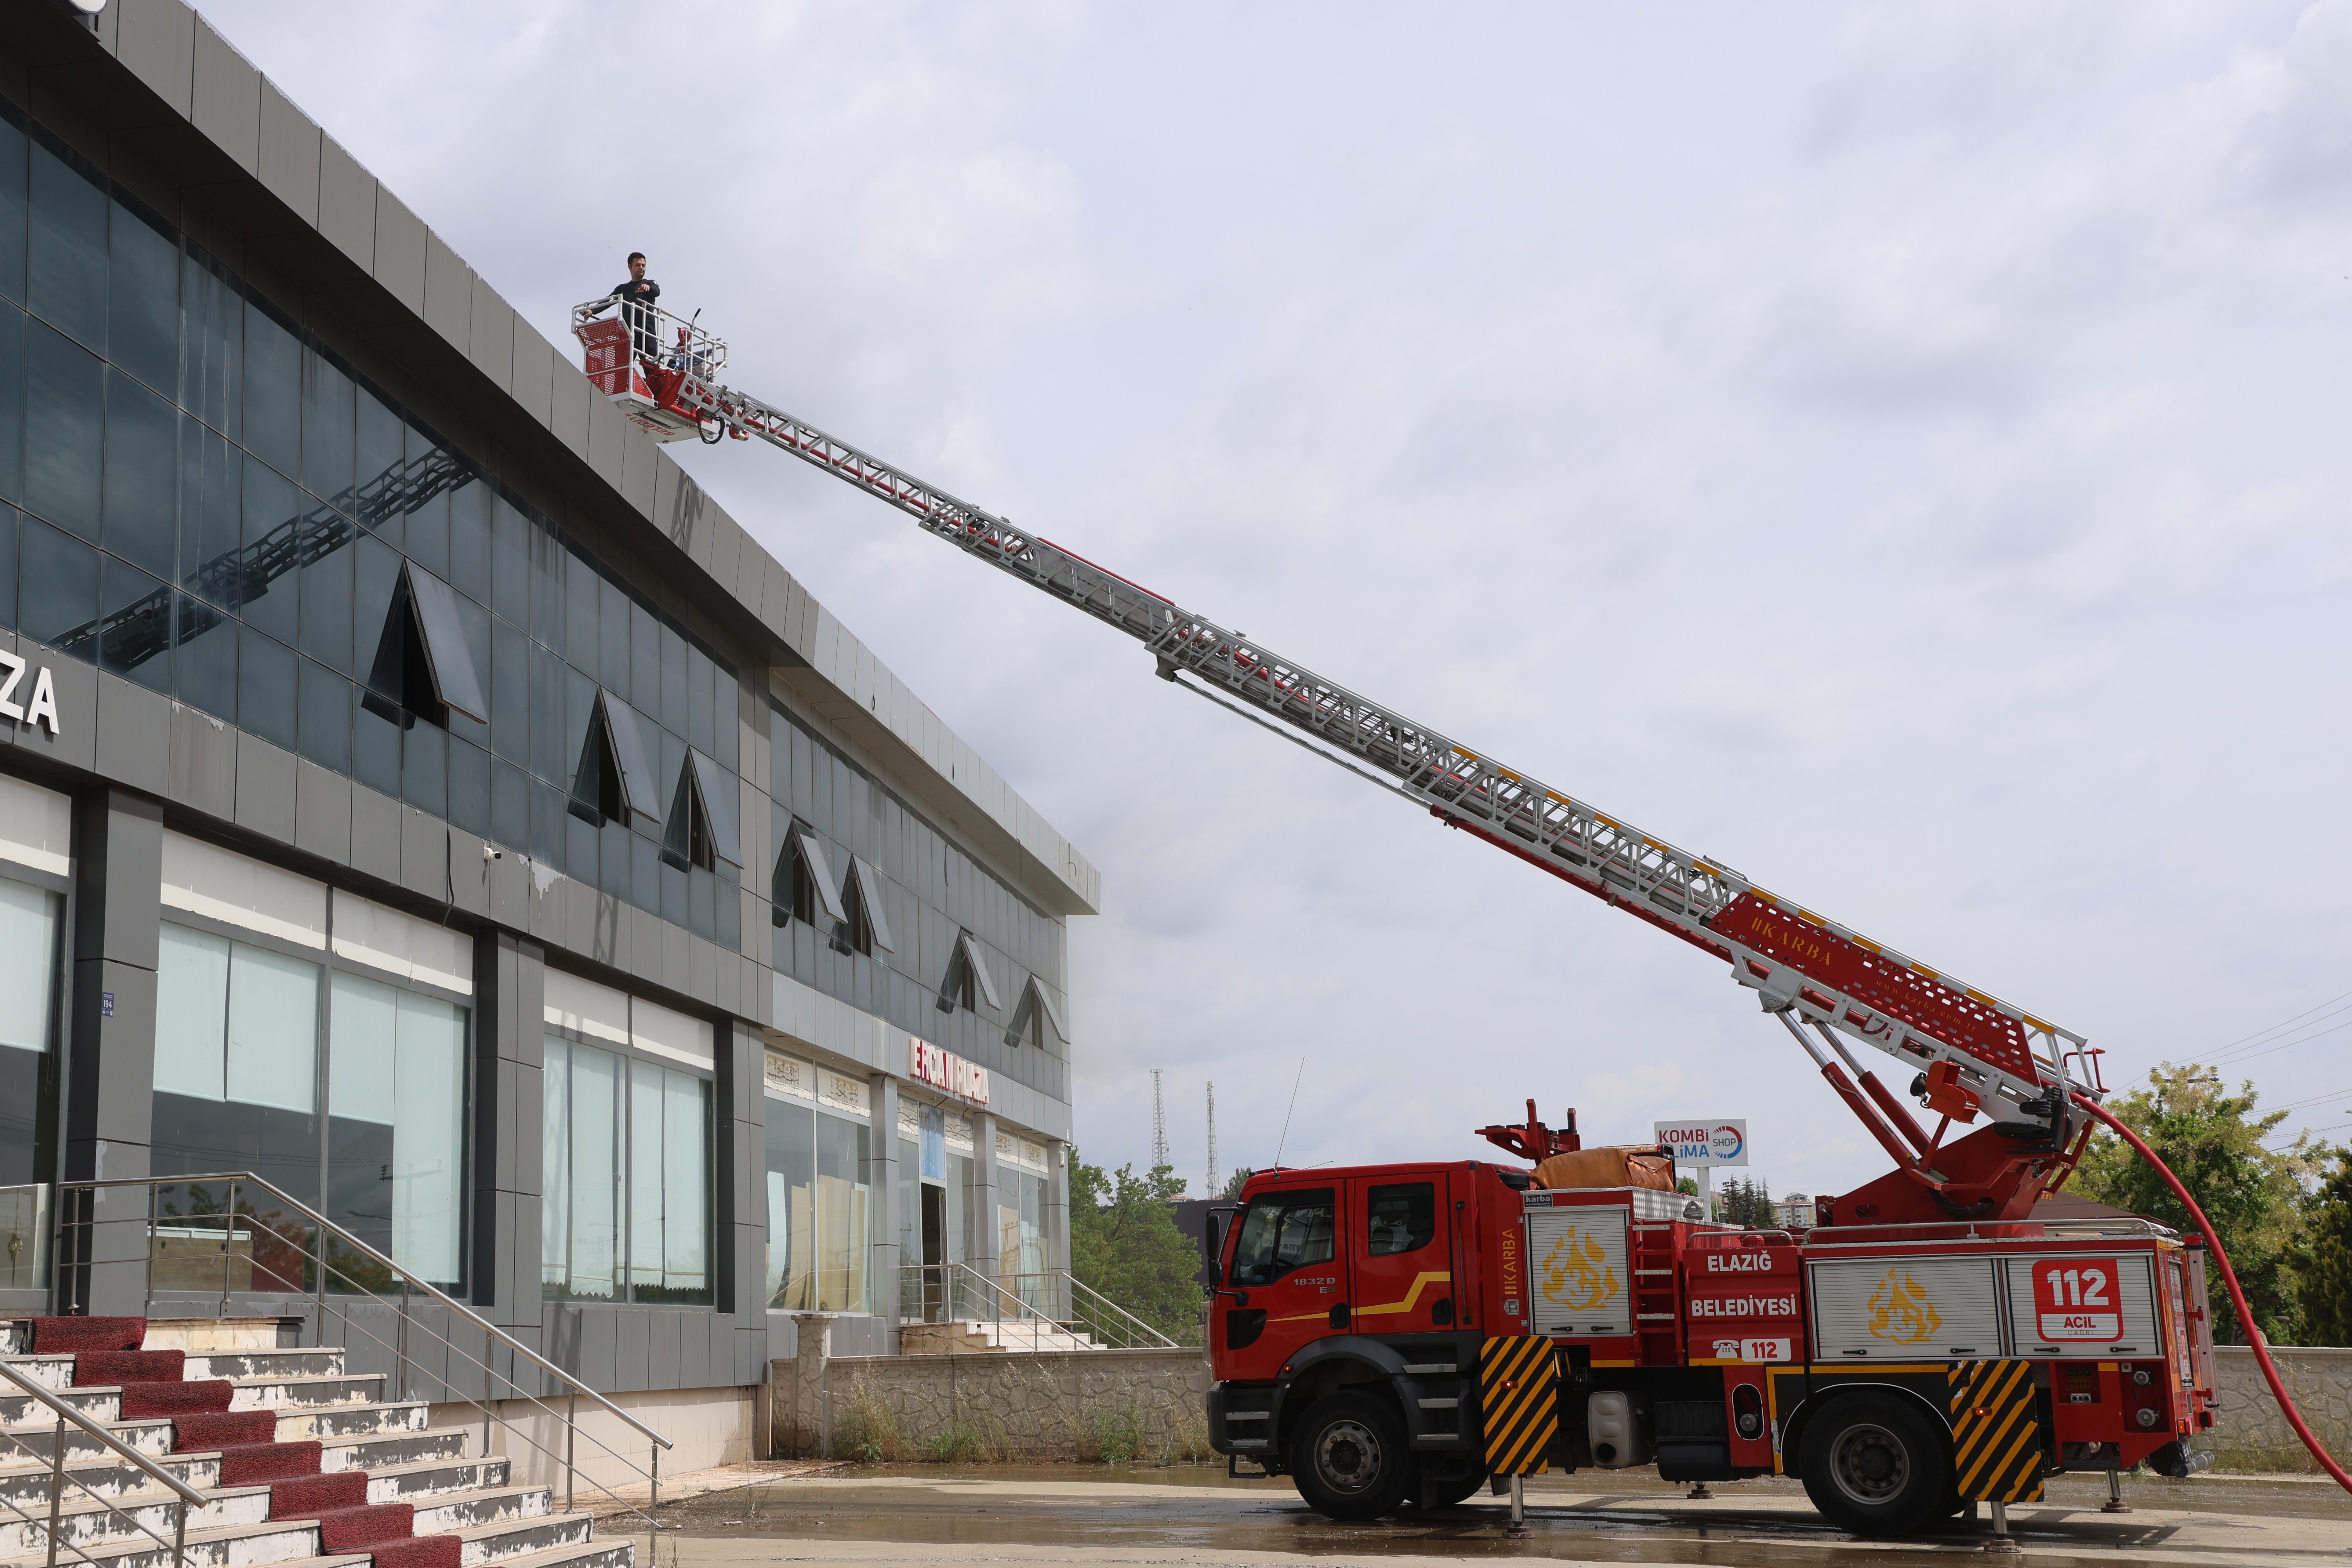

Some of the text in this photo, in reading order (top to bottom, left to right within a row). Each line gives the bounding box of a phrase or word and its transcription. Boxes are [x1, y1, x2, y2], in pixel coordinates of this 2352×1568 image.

[103, 1000, 112, 1008] 194
[1877, 980, 1977, 1032] www.karba.com.tr
[910, 1037, 989, 1104] ERCAN PLAZA
[1713, 1138, 1736, 1147] SHOP
[1708, 1250, 1772, 1272] ELAZIĞ
[2047, 1269, 2109, 1306] 112
[1691, 1294, 1796, 1316] BELEDİYESİ
[1751, 1341, 1778, 1358] 112
